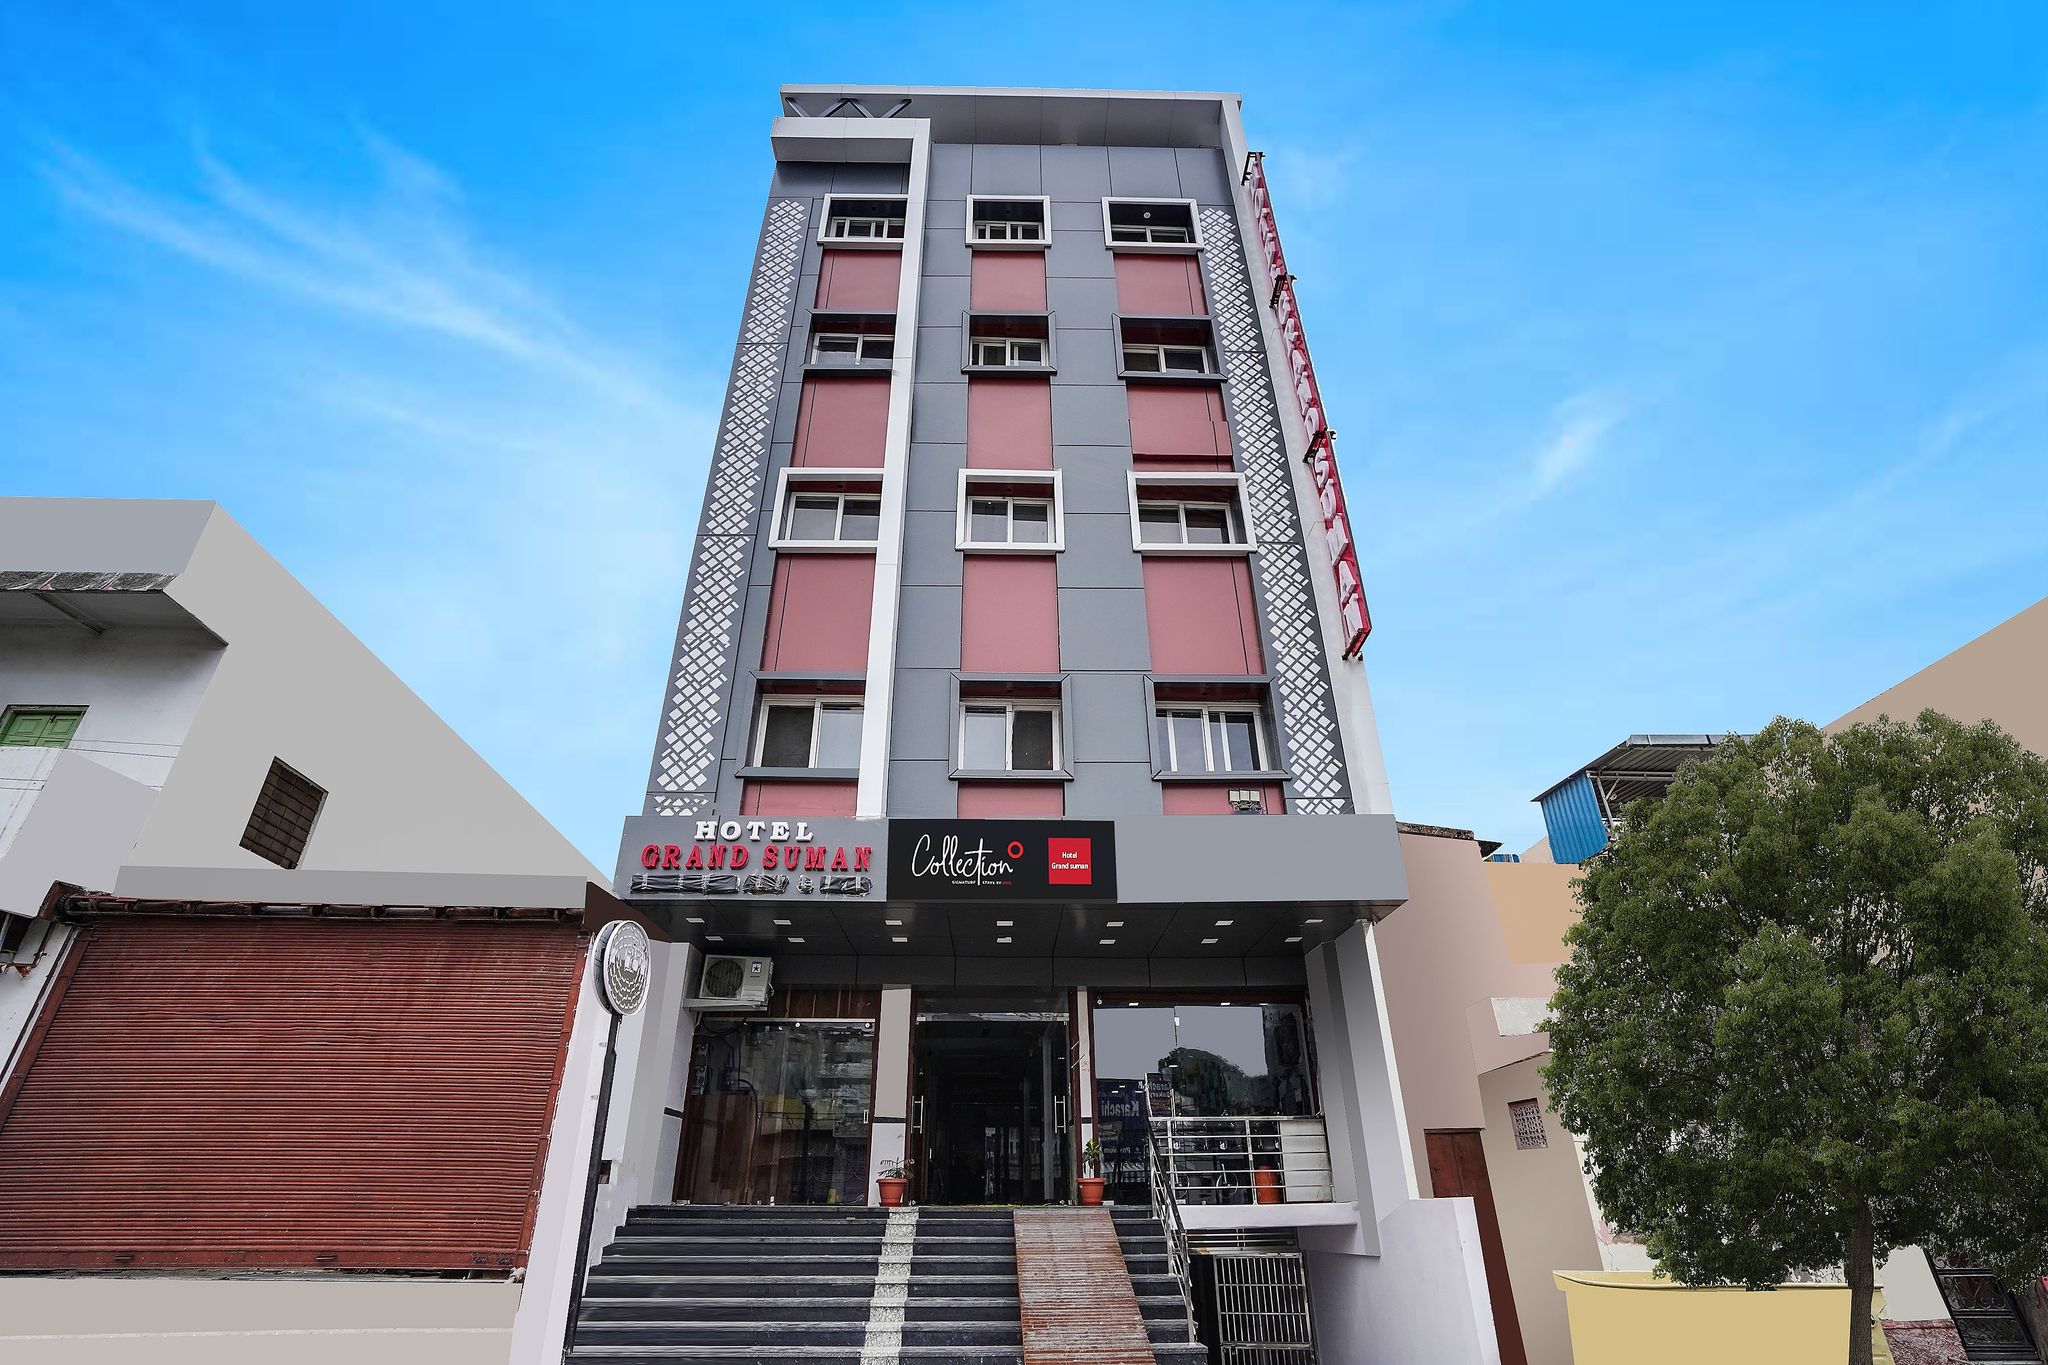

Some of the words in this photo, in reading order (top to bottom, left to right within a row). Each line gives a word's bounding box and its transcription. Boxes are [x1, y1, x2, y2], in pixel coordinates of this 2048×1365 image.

[1314, 447, 1359, 646] SUMAN
[694, 821, 814, 842] HOTEL
[641, 845, 750, 870] GRAND
[762, 844, 872, 871] SUMAN
[911, 833, 1014, 886] Collection
[1051, 862, 1069, 870] Grand
[1061, 851, 1079, 859] Hotel
